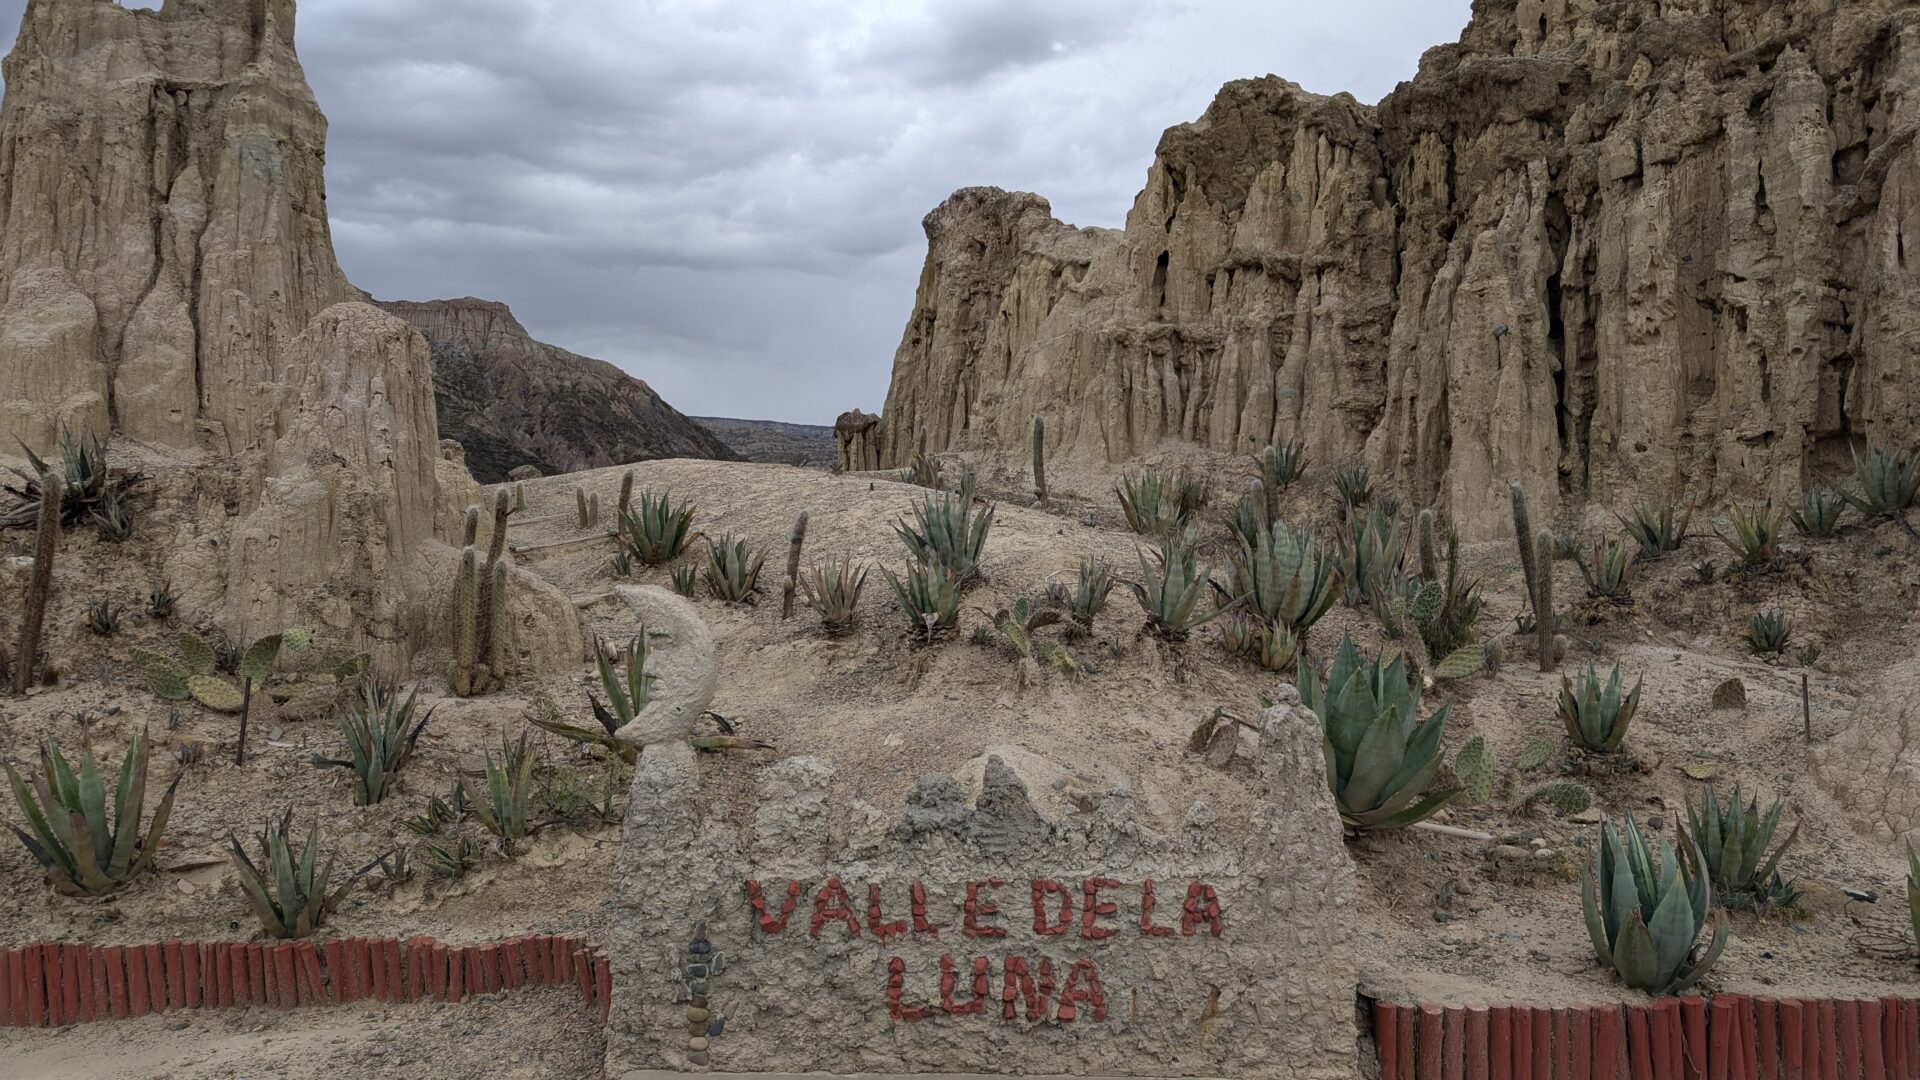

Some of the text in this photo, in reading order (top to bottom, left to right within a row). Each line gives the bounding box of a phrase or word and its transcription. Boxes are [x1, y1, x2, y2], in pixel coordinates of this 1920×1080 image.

[746, 875, 1224, 946] VALLE DE LA
[887, 953, 1107, 1023] LUNA
